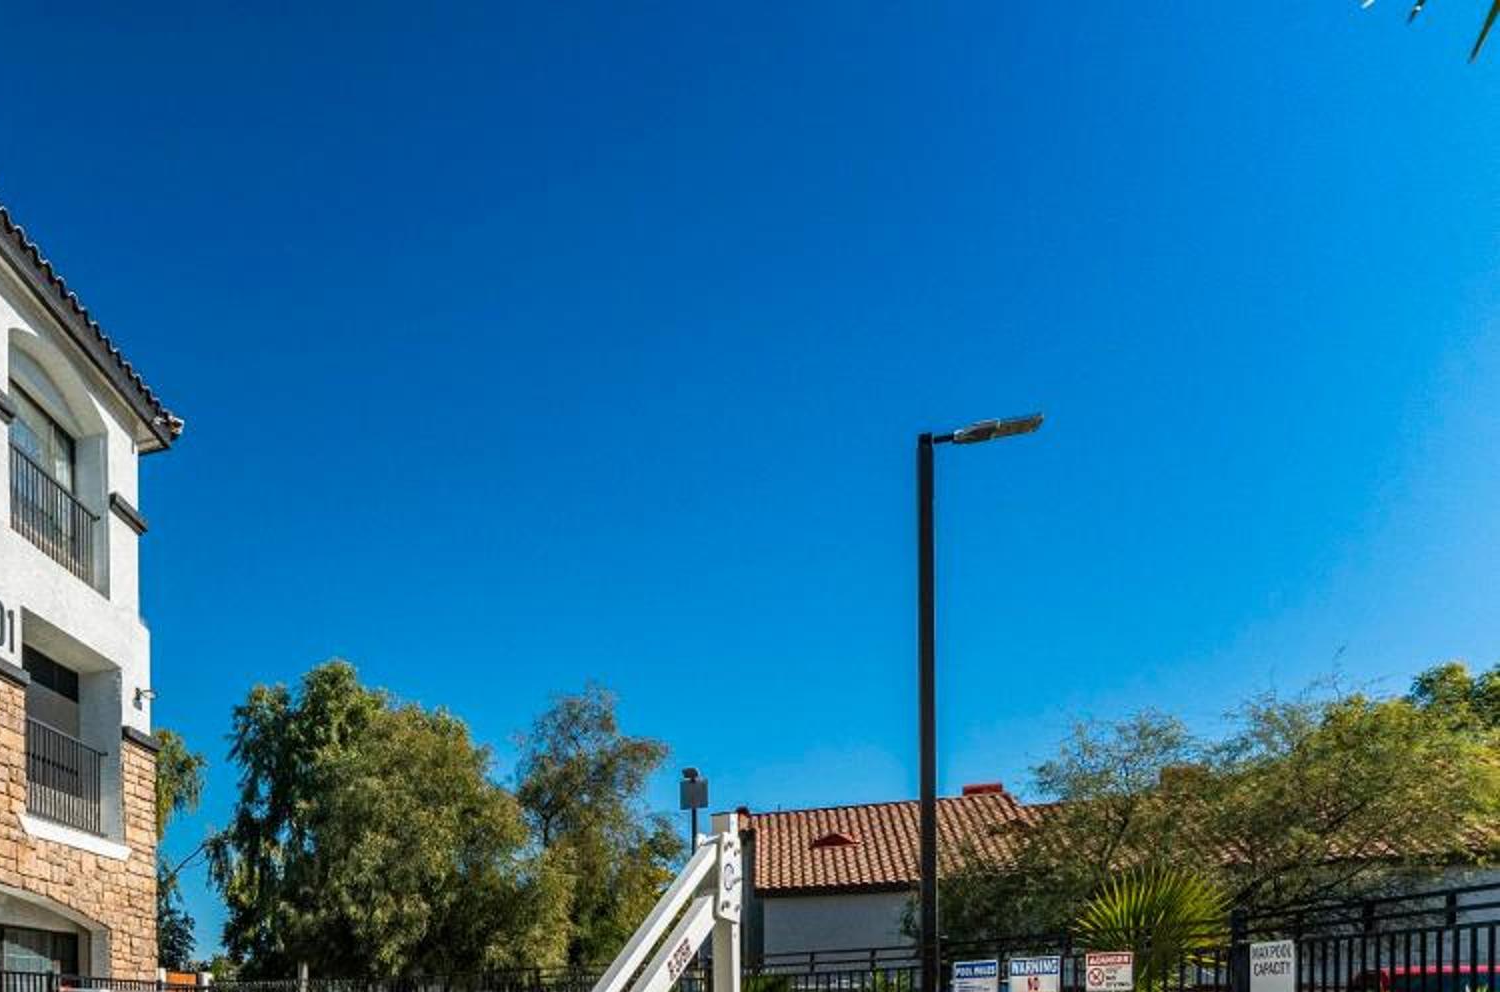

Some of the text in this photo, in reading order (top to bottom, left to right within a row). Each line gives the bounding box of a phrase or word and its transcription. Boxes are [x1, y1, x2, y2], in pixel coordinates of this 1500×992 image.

[1011, 960, 1057, 975] WARNING
[1253, 961, 1291, 976] CAPACITY
[1027, 977, 1039, 991] NO
